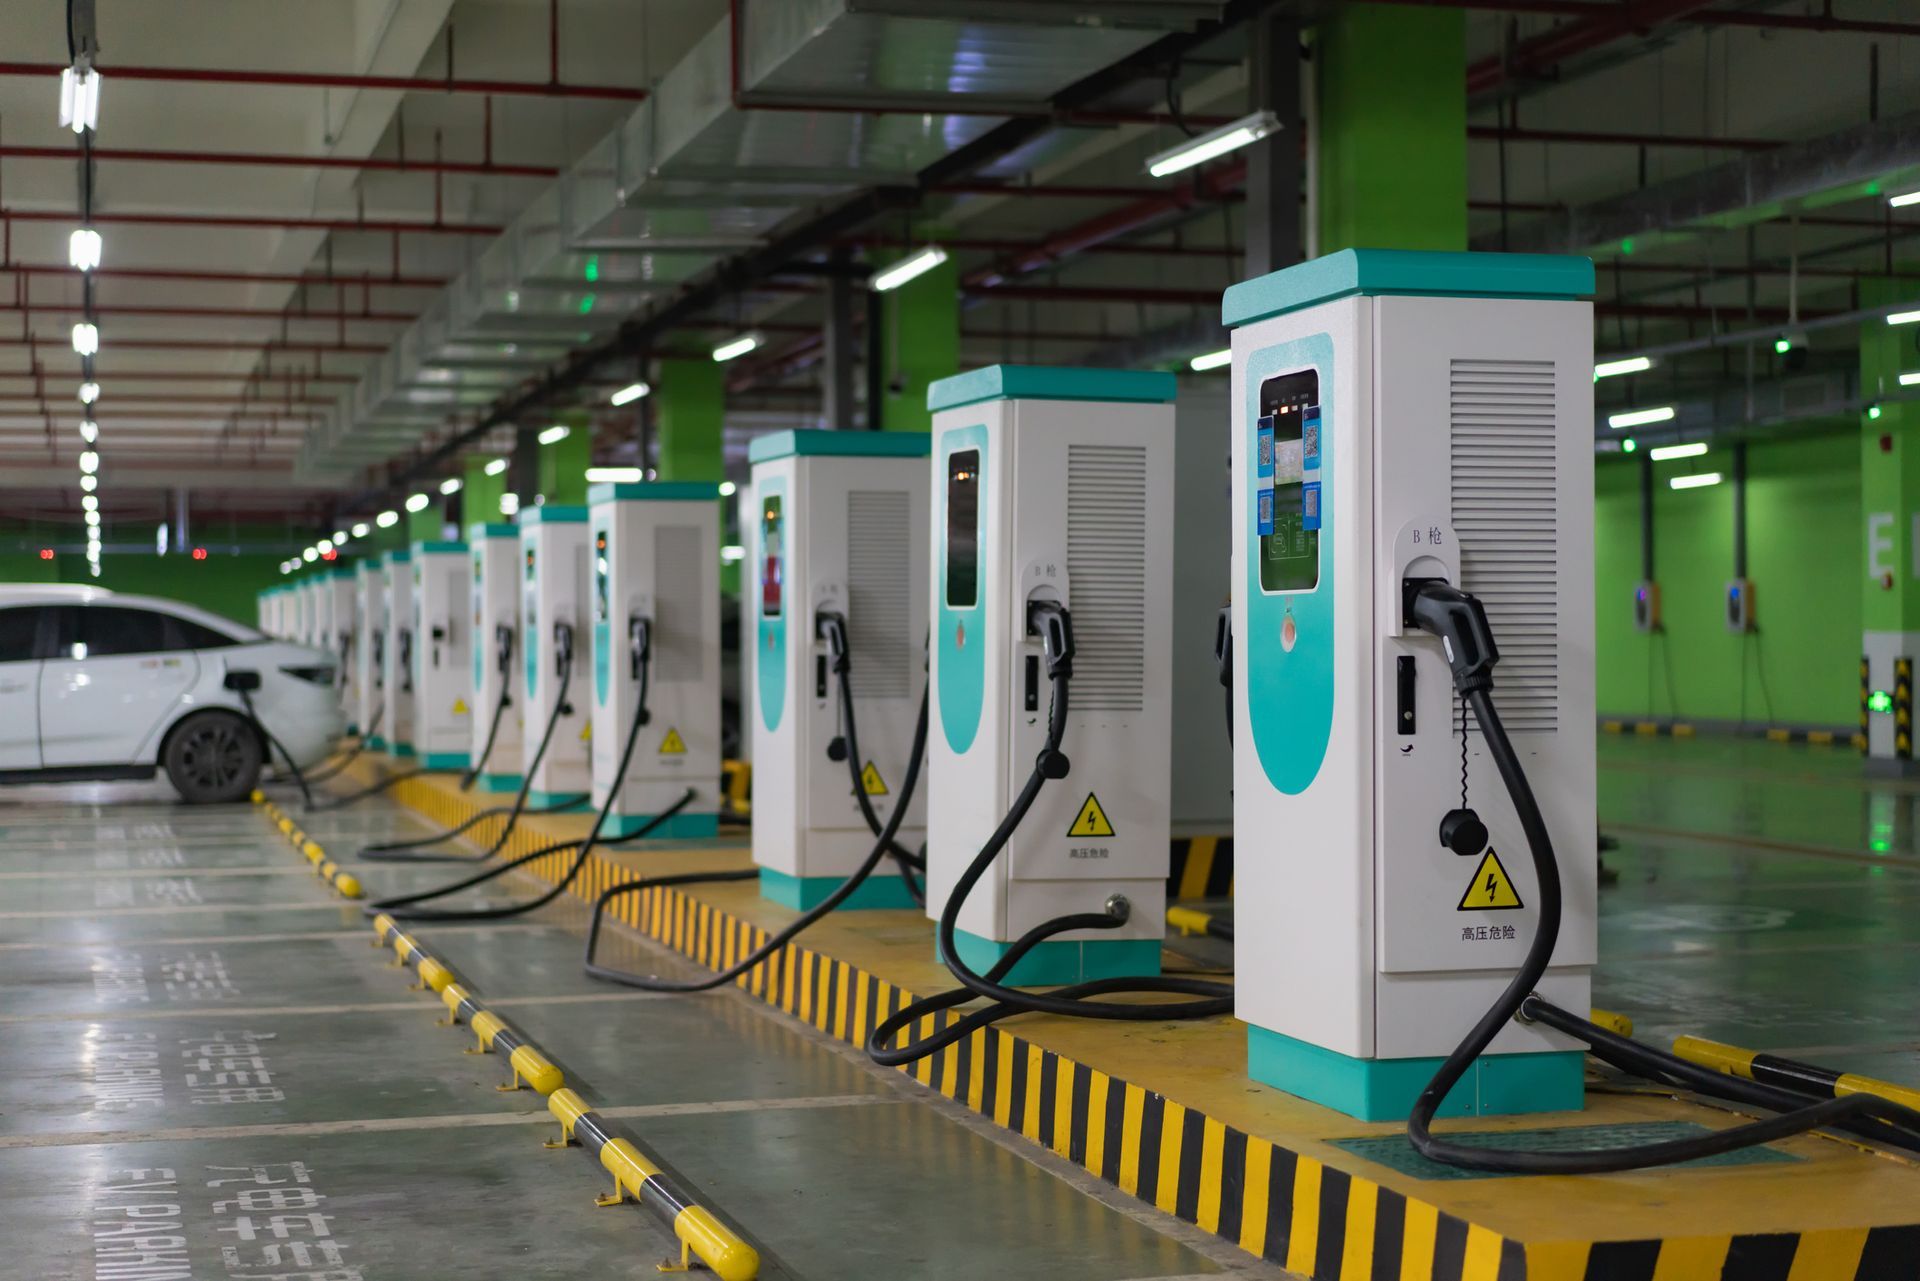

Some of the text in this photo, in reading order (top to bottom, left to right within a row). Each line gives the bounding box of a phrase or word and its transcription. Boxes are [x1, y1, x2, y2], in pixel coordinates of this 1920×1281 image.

[1413, 526, 1442, 545] B 枪
[1868, 512, 1894, 579] E
[1461, 924, 1516, 941] 高压危险
